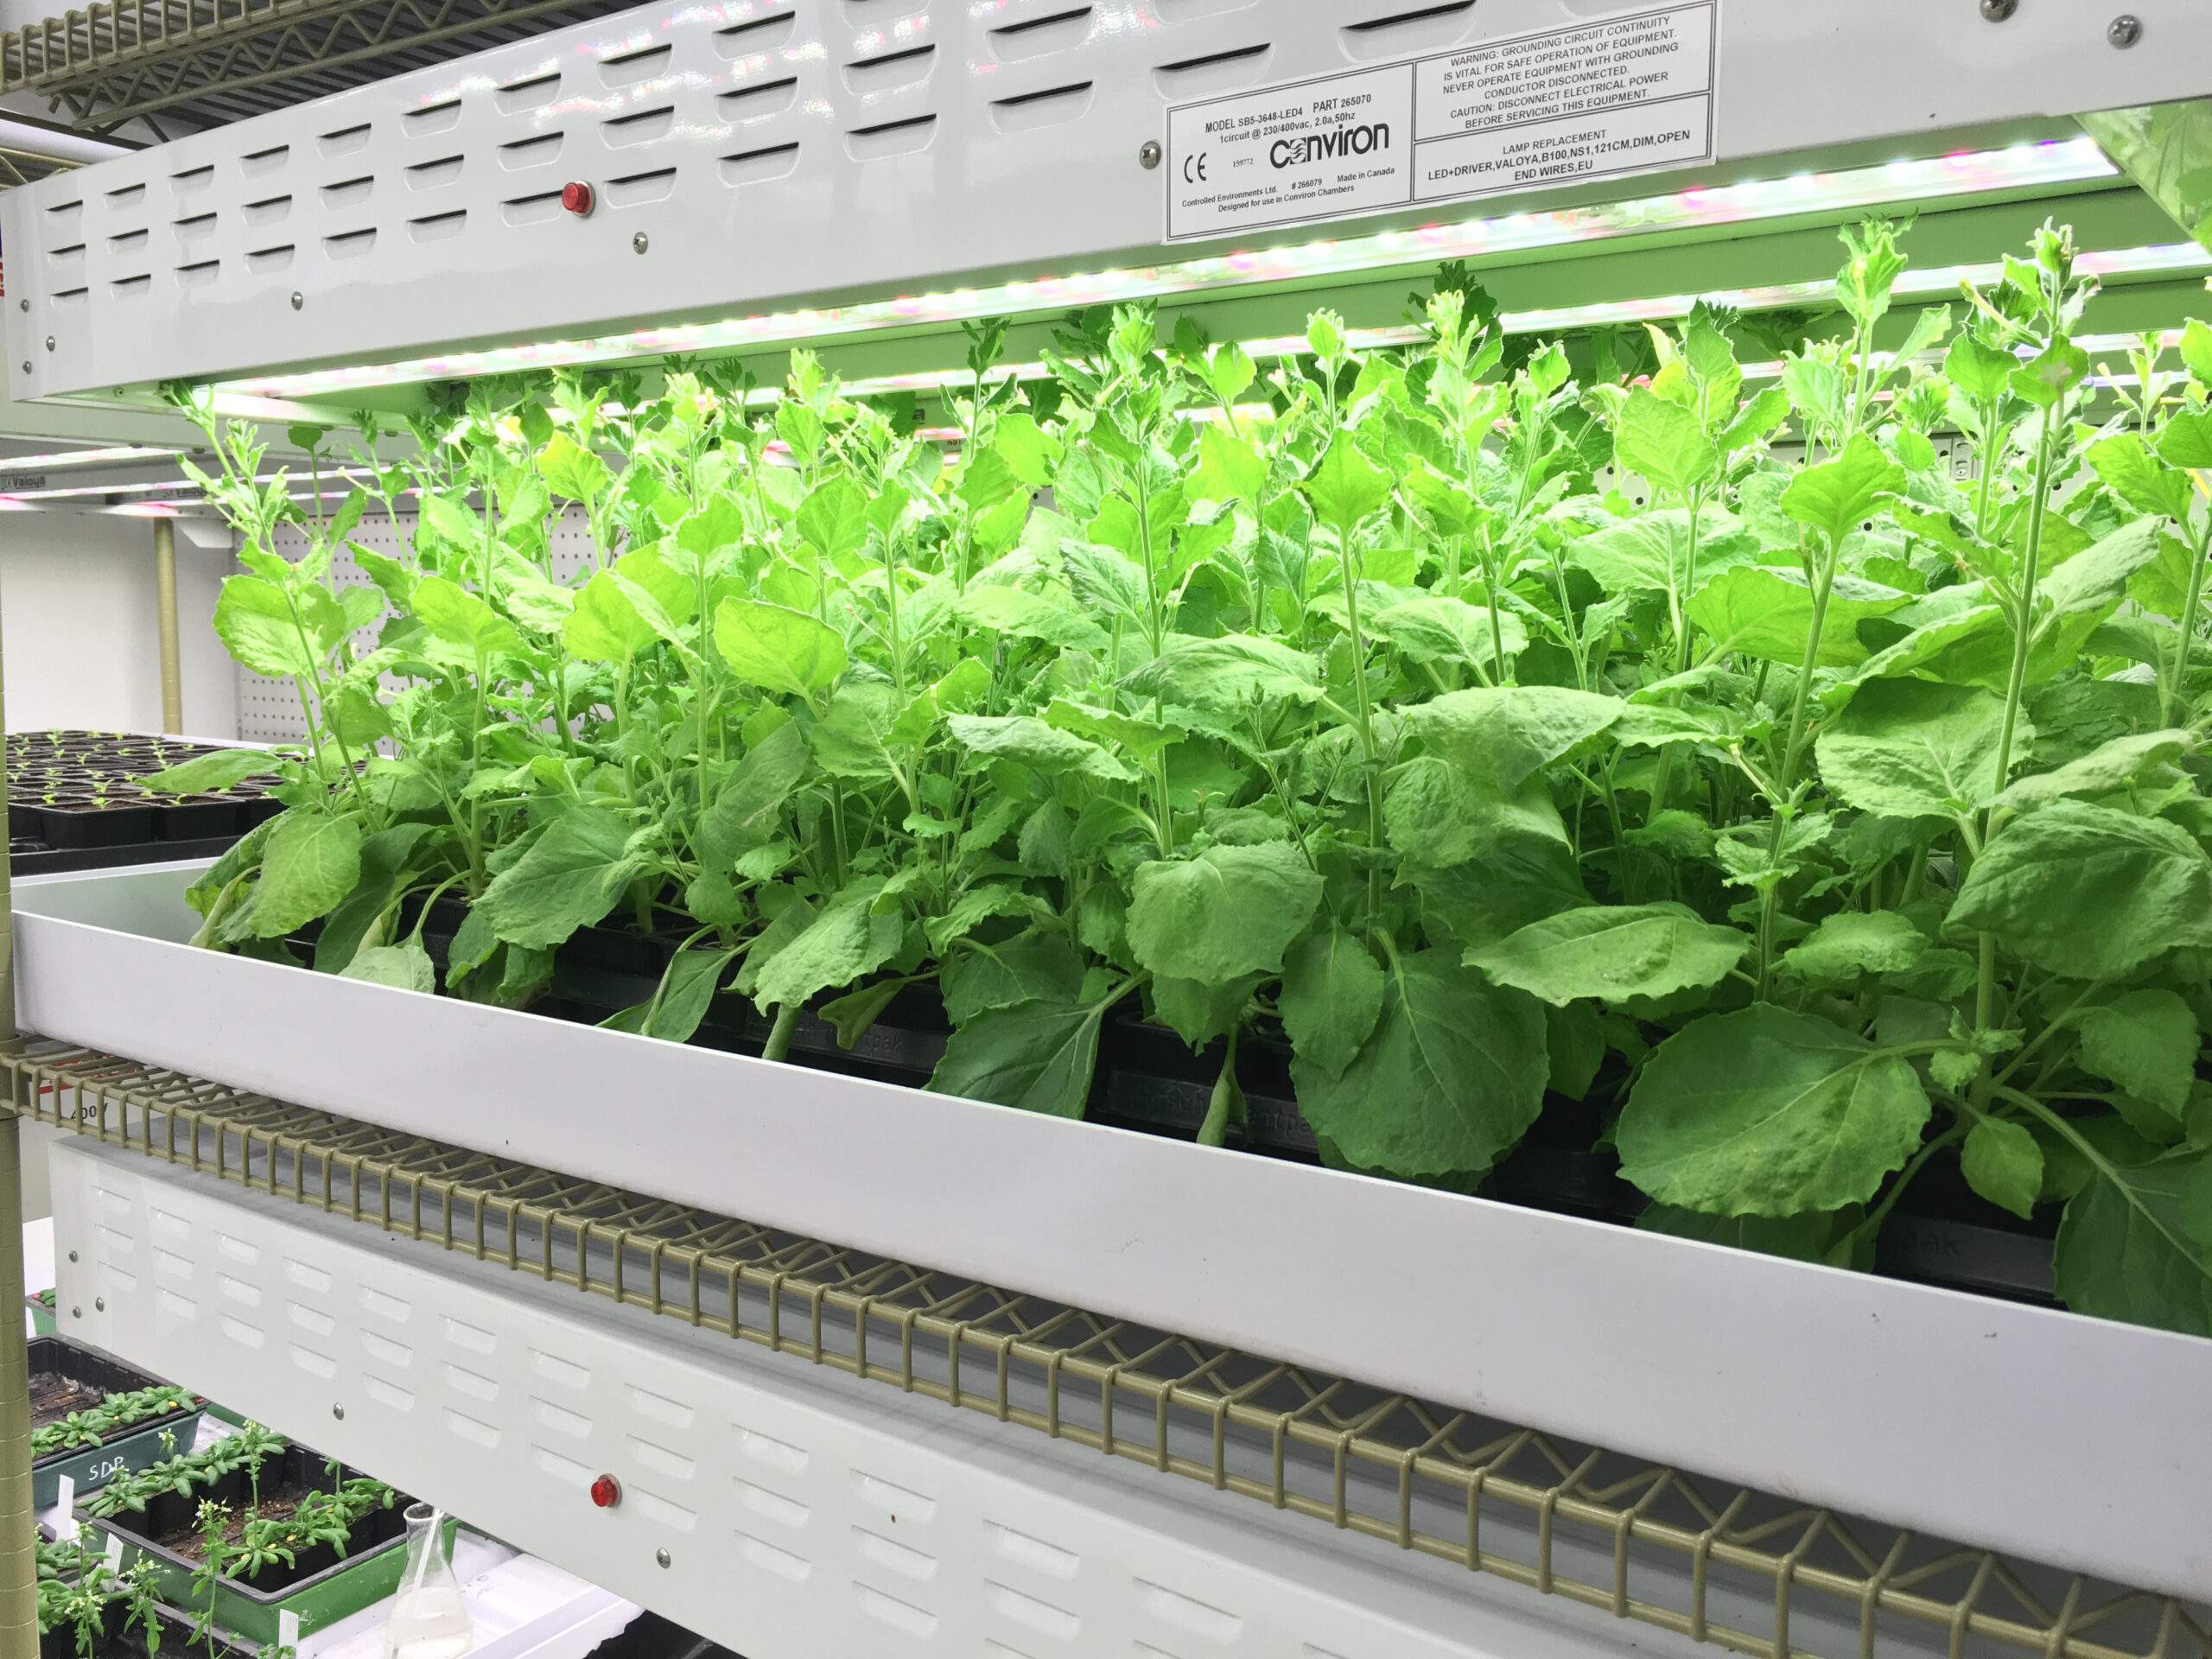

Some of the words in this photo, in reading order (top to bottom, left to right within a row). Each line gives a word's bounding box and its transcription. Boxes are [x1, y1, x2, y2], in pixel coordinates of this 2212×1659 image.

[1444, 72, 1452, 80] IS
[1455, 67, 1482, 79] VITAL
[1484, 62, 1504, 73] FOR
[1507, 56, 1532, 69] SAFE
[1535, 45, 1592, 63] OPERATION
[1596, 41, 1610, 52] OF
[1612, 29, 1677, 48] EQUIPMENT.
[1451, 51, 1499, 67] WARNING:
[1502, 37, 1561, 56] GROUNDING
[1564, 29, 1605, 45] CIRCUIT
[1607, 16, 1670, 35] CONTINUITY
[1443, 80, 1474, 94] NEVER
[1477, 72, 1522, 88] OPERATE
[1524, 60, 1582, 79] EQUIPMENT
[1586, 54, 1610, 67] WITH
[1613, 41, 1679, 62] GROUNDING
[1484, 80, 1545, 99] CONDUCTOR
[1548, 65, 1630, 87] DISCONNECTED.
[1450, 104, 1495, 118] CAUTION:
[1497, 91, 1560, 110] DISCONNECT
[1564, 79, 1626, 98] ELECTRICAL
[1629, 71, 1669, 86] POWER
[1465, 114, 1503, 129] BEFORE
[1506, 105, 1559, 122] SERVICING
[1562, 99, 1584, 111] THIS
[1586, 88, 1650, 107] EQUIPMENT.
[1205, 118, 1236, 133] MODEL
[1238, 107, 1303, 127] SB5-3648-LED4
[1313, 99, 1338, 113] PART
[1340, 94, 1371, 108] 265070
[1220, 130, 1250, 143] 1circuit
[1252, 129, 1262, 140] @
[1263, 121, 1312, 136] 230/400vac,
[1315, 112, 1356, 127] 2.0a,50hz
[1503, 142, 1529, 155] LAMP
[1532, 130, 1607, 149] REPLACEMENT
[1298, 178, 1323, 189] 266079
[1337, 172, 1357, 182] Made
[1358, 171, 1365, 180] in
[1367, 167, 1395, 178] Canada
[1515, 168, 1536, 181] END
[1539, 160, 1593, 176] WIRES,EU
[1182, 196, 1216, 207] Controlled
[1217, 188, 1263, 202] Environments
[1265, 185, 1278, 194] Ltd.
[1218, 200, 1249, 213] Designed
[1284, 189, 1315, 202] Conviron
[1318, 185, 1355, 197] Chambers
